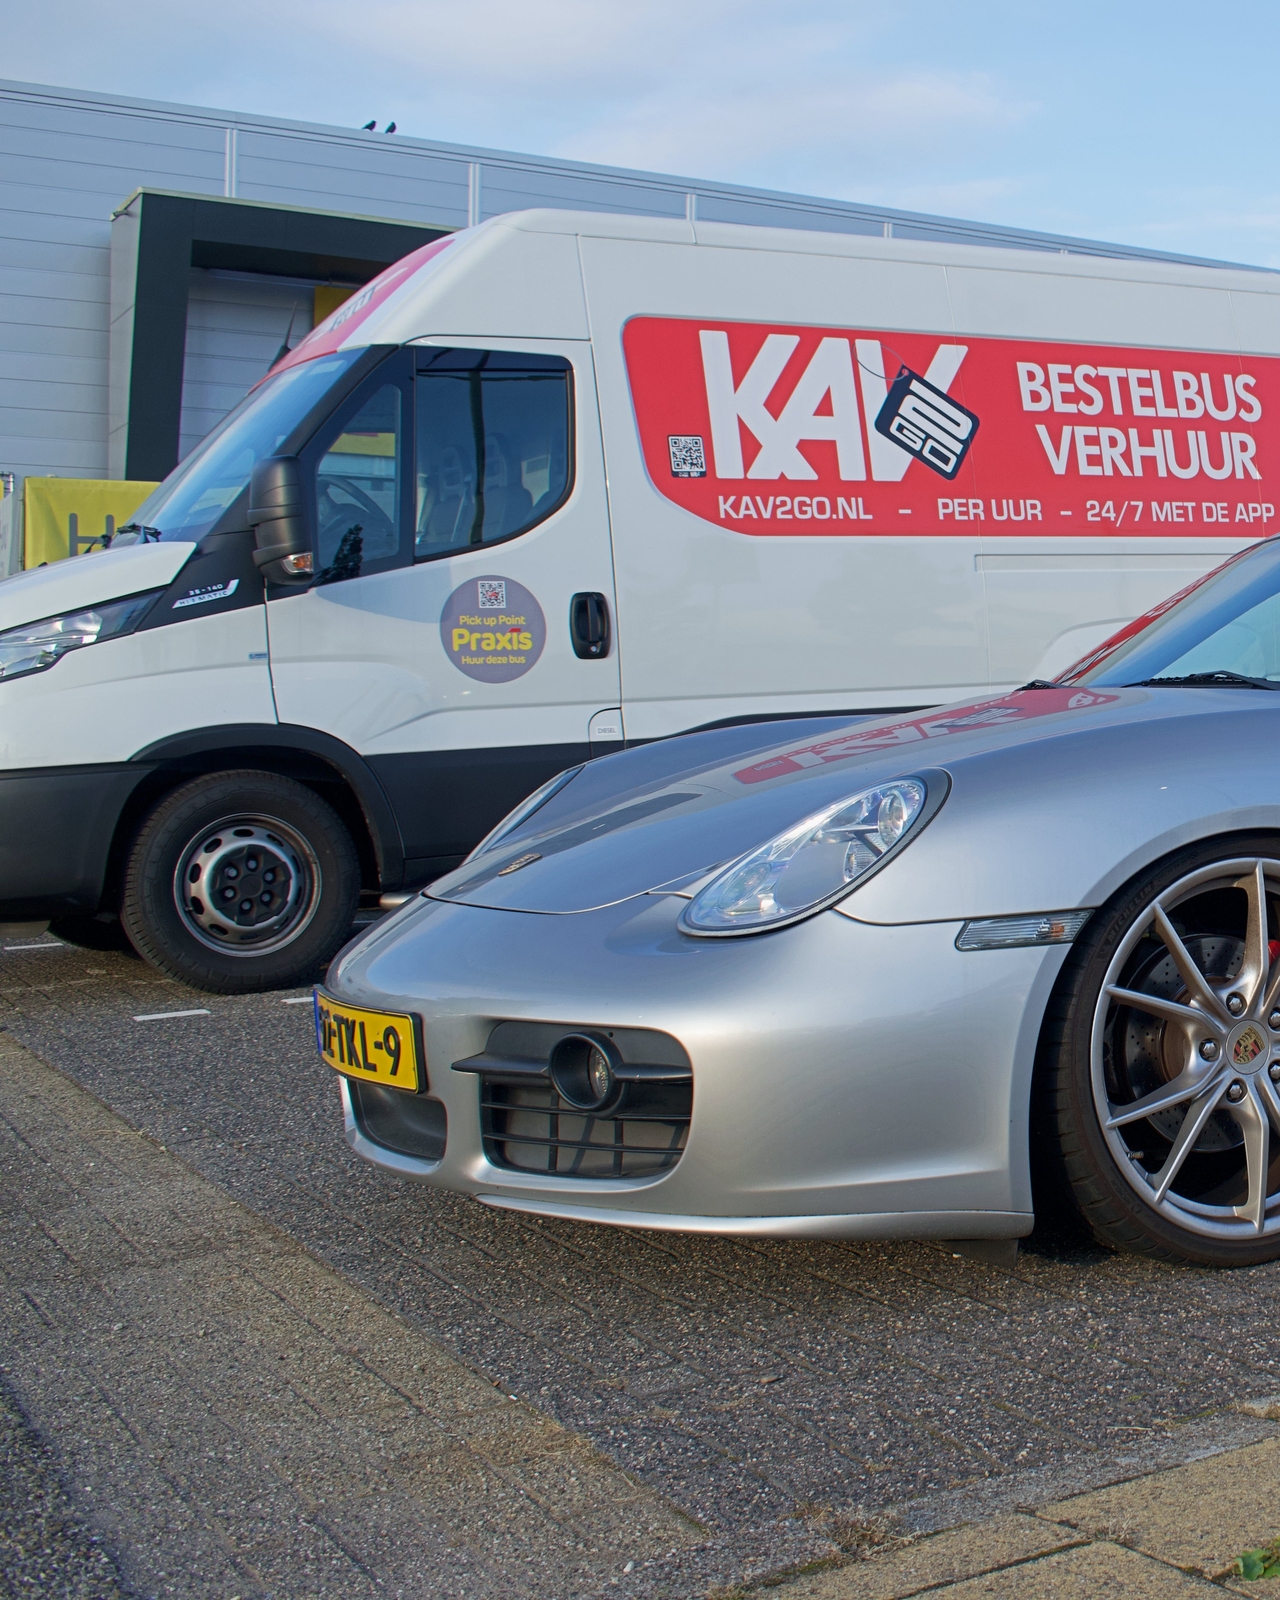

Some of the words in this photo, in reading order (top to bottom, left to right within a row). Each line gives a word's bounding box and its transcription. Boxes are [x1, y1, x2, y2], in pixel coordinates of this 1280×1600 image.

[699, 330, 968, 482] KAV
[1016, 361, 1262, 422] BESTELBUS
[1035, 424, 1262, 480] VERHUUR
[718, 496, 873, 520] KAV2GO.NL
[938, 498, 985, 521] PER
[991, 499, 1042, 521] UUR
[1086, 500, 1143, 527] 24/7
[1151, 501, 1196, 522] MET
[1202, 502, 1229, 522] DE
[1235, 503, 1275, 523] APP
[452, 627, 532, 651] Praxis
[459, 615, 482, 625] Pick
[483, 617, 497, 626] up
[498, 615, 526, 625] Point
[461, 655, 485, 664] Huur
[486, 655, 507, 664] deze
[509, 654, 526, 664] bus
[1108, 884, 1153, 942] MICHELIN
